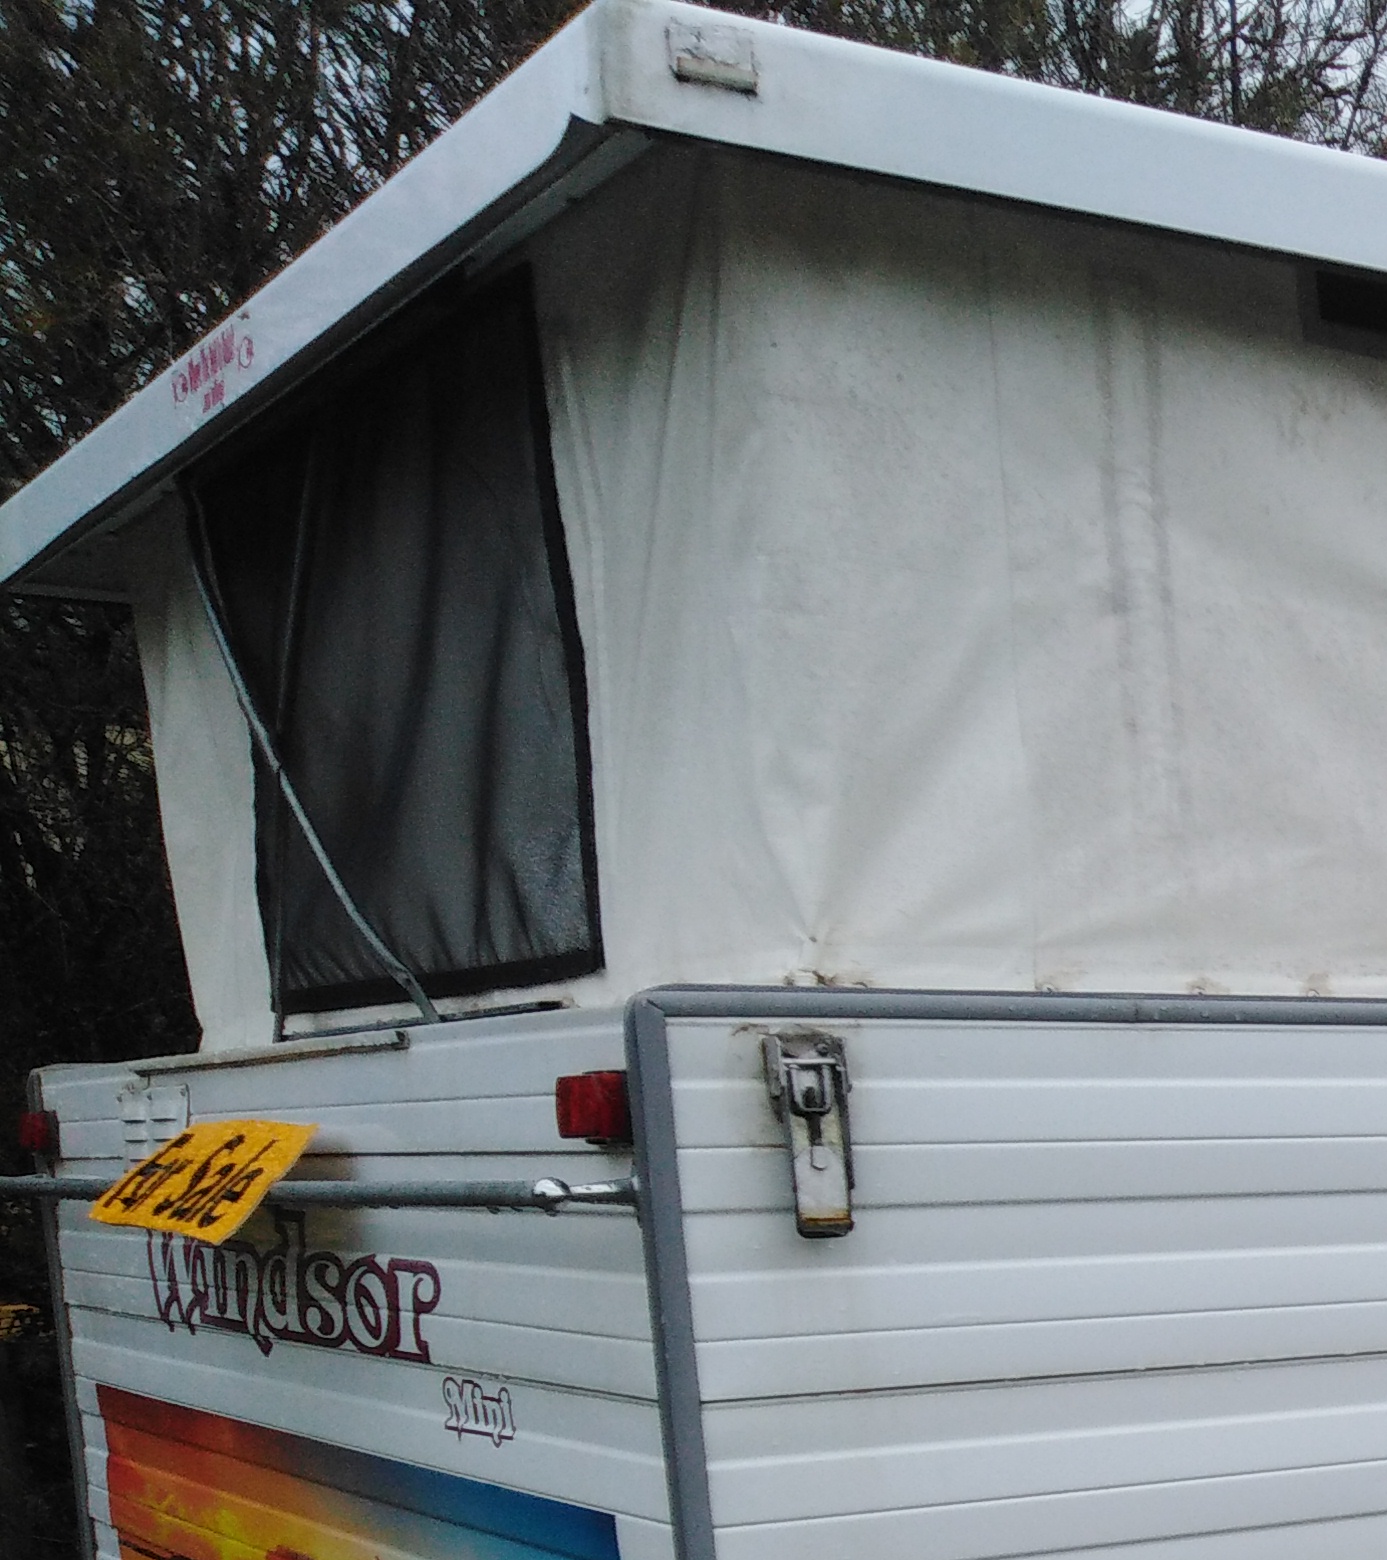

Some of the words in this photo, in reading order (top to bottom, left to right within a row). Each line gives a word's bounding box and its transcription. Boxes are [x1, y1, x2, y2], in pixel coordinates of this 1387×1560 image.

[153, 1134, 280, 1228] Sale
[146, 1207, 441, 1364] Windsor
[442, 1376, 516, 1447] Mini
